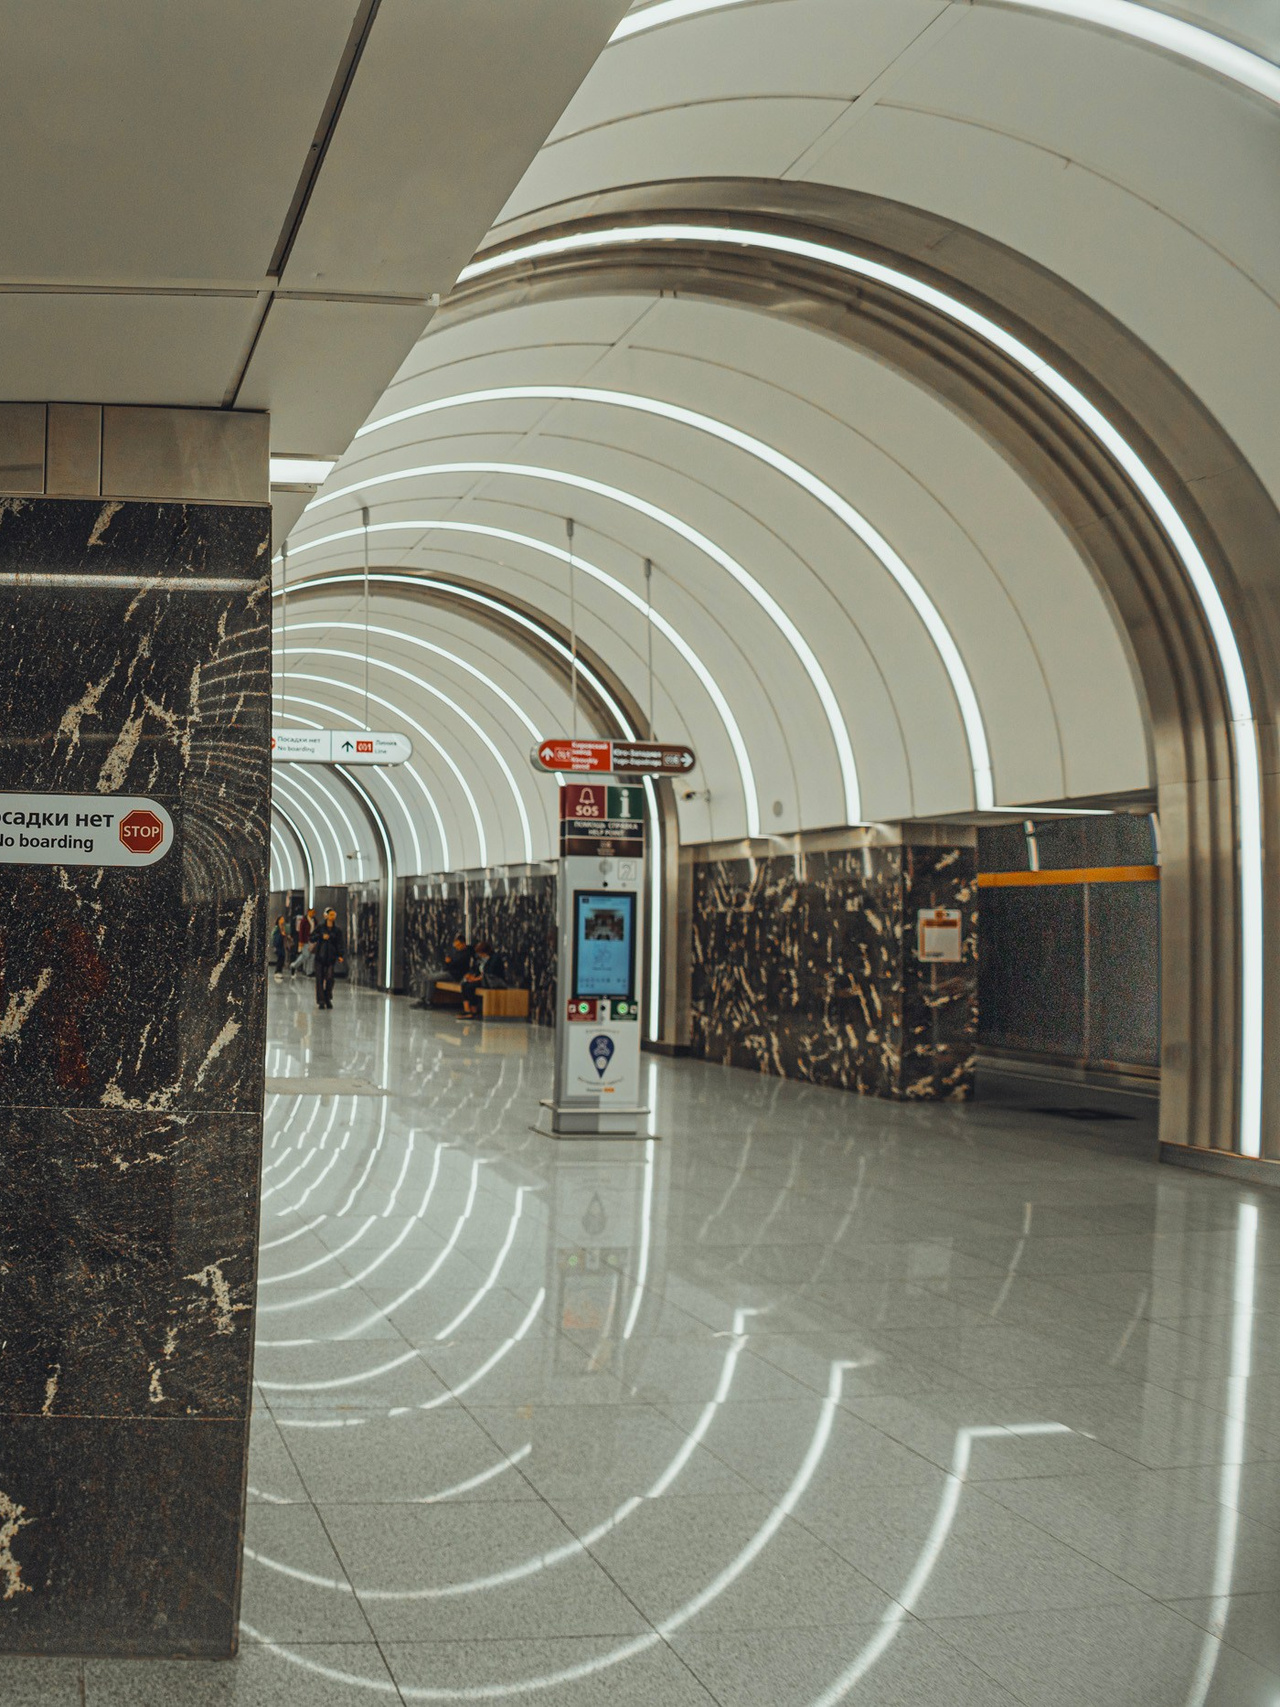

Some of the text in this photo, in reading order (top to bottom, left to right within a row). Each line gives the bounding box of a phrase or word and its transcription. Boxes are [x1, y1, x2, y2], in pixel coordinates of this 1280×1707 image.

[575, 805, 599, 816] SOS
[76, 813, 114, 828] нет
[123, 825, 160, 838] STOP
[19, 834, 94, 853] boarding
